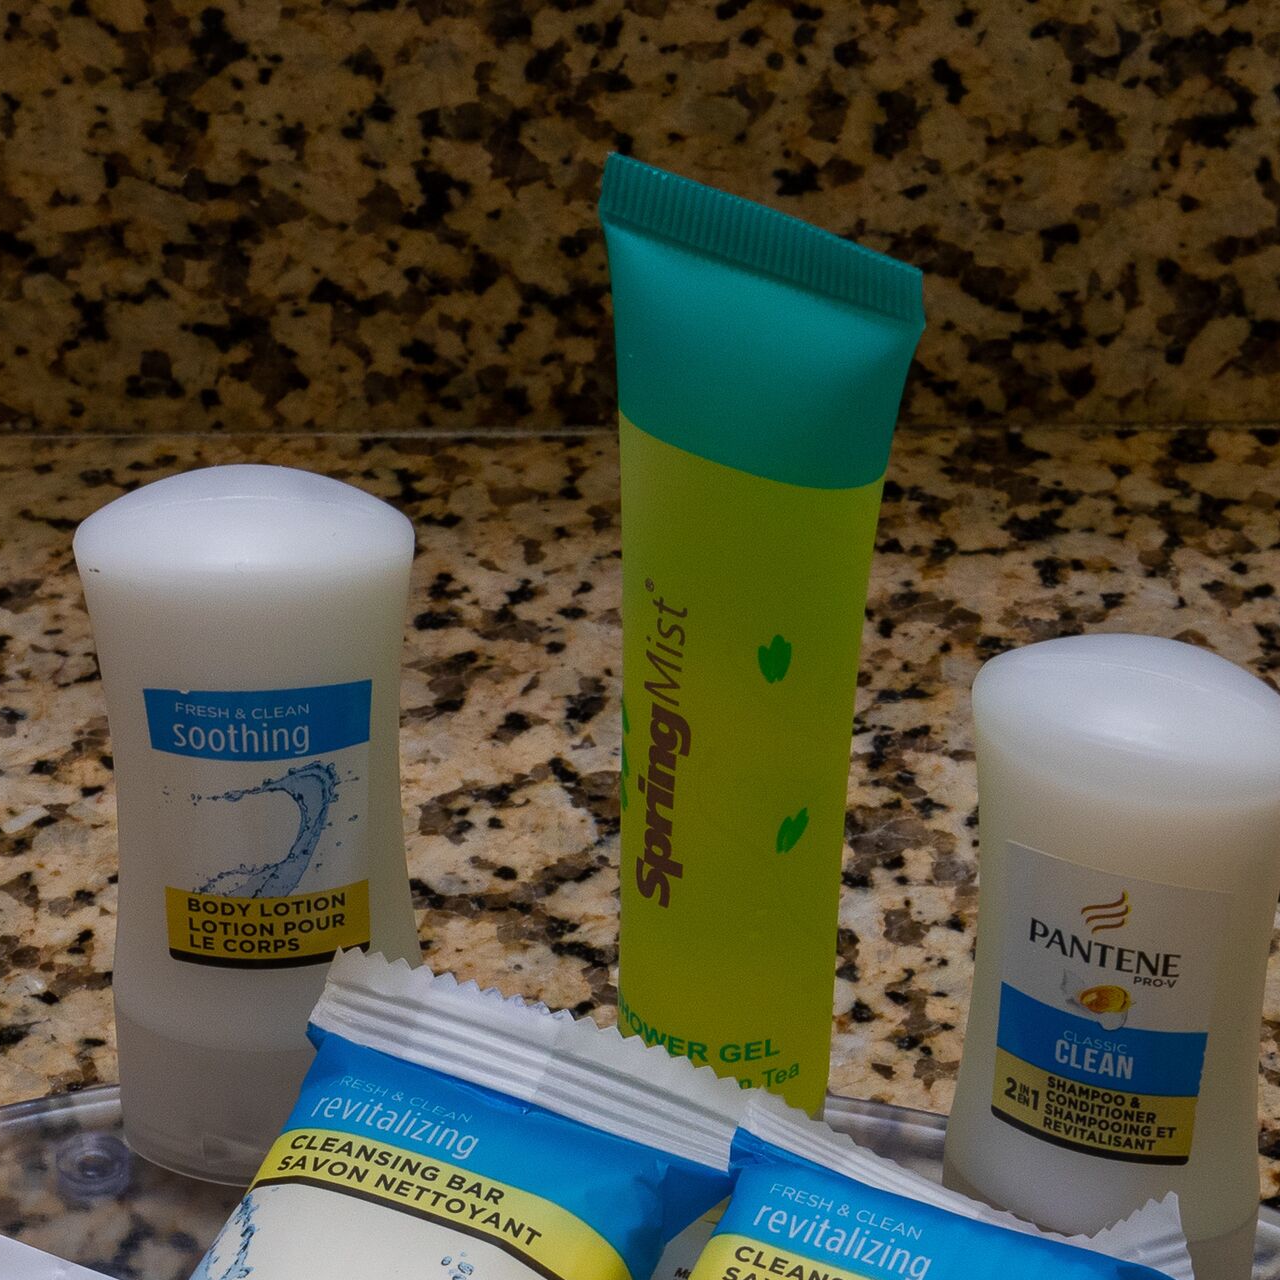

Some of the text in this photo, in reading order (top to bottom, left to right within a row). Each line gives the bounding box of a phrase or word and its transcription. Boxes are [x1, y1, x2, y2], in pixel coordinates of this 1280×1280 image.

[175, 702, 310, 720] FRESH & CLEAN
[173, 723, 310, 754] soothing
[187, 892, 346, 917] BODY LOTION
[188, 913, 346, 937] LOTION POUR
[189, 934, 301, 954] LE CORPS
[1029, 917, 1182, 978] PANTENE
[619, 994, 708, 1062] HOWER
[719, 1038, 780, 1063] GEL
[1063, 1030, 1128, 1054] CLASSIC
[762, 1063, 800, 1087] Tea
[1055, 1039, 1134, 1080] CLEAN
[1004, 1077, 1018, 1100] 2
[1048, 1076, 1141, 1109] SHAMPOO &
[391, 1091, 405, 1102] &
[409, 1097, 473, 1123] CLEAN
[1044, 1104, 1177, 1139] SHAMPOOING ET
[1046, 1090, 1157, 1124] CONDITIONER
[311, 1095, 479, 1160] revitalizing
[1043, 1117, 1156, 1151] REVITALISANT
[290, 1135, 505, 1205] CLEANSING BAR
[277, 1155, 543, 1246] SAVON NETTOYANT
[770, 1183, 923, 1240] FRESH & CLEAN
